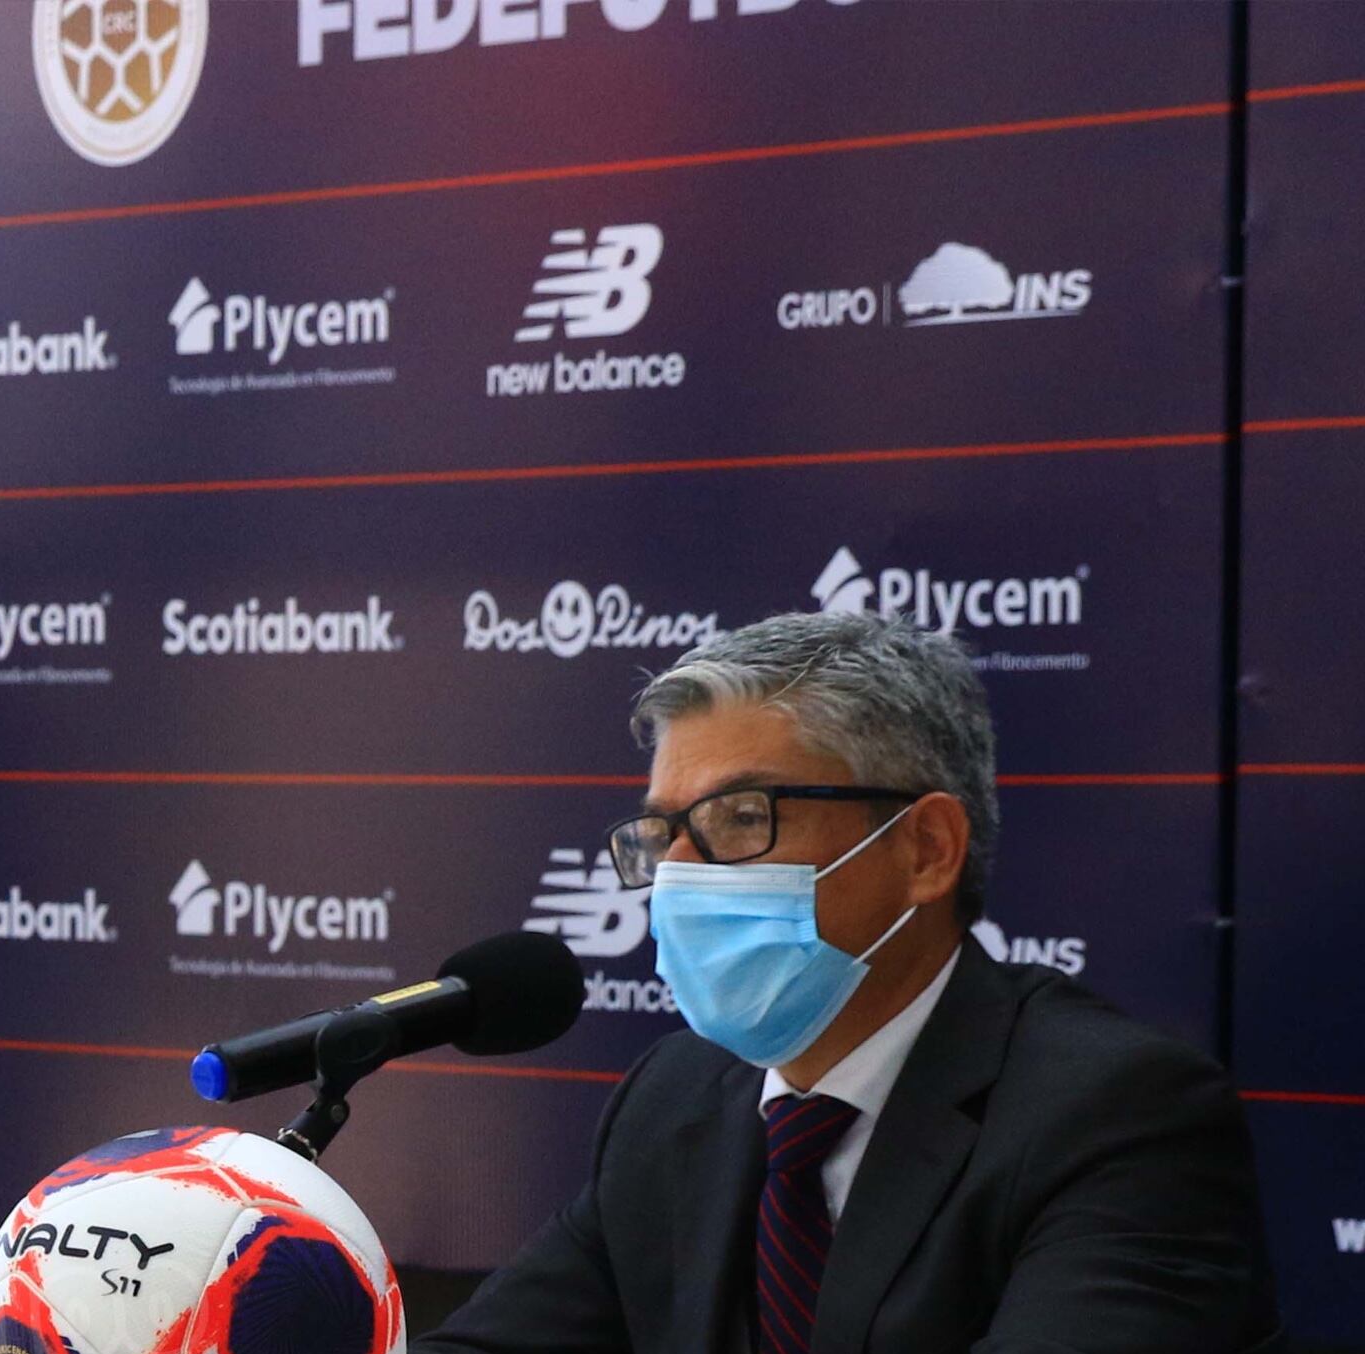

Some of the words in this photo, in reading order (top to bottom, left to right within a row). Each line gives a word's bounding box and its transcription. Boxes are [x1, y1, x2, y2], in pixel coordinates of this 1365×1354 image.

[777, 287, 876, 330] GRUPO
[1014, 269, 1093, 312] INS
[224, 295, 389, 366] Plycem
[487, 358, 546, 397] new
[554, 349, 686, 394] balance
[163, 596, 397, 654] Scotiabank
[464, 589, 542, 651] Dos
[592, 583, 724, 648] Pinos
[879, 567, 1083, 637] Plycem
[224, 881, 389, 952] Plycem
[1010, 936, 1086, 976] INS
[583, 971, 676, 1012] alance
